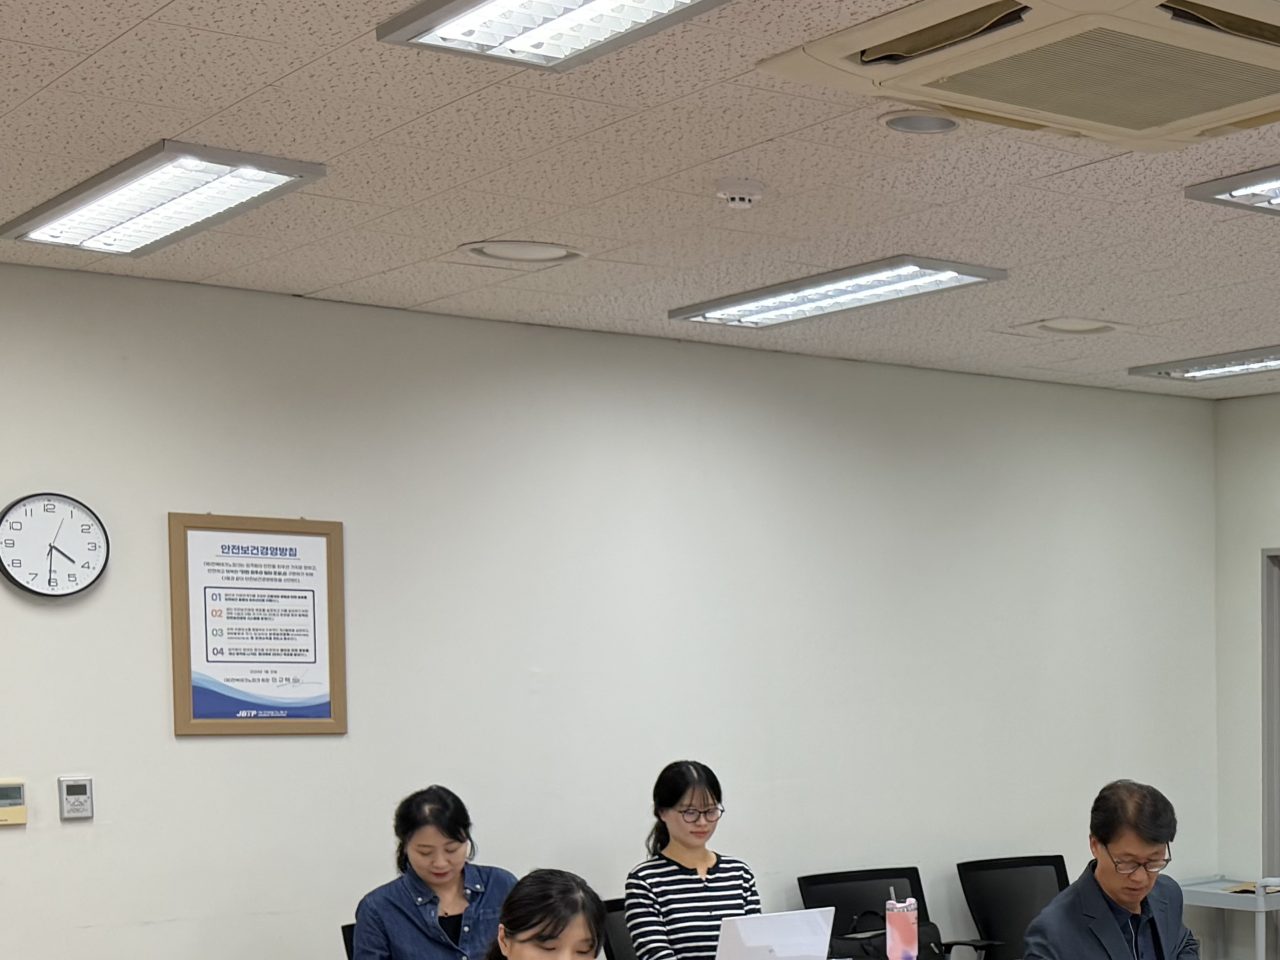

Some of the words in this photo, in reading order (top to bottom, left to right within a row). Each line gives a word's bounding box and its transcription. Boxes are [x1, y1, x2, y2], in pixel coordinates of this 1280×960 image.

[25, 508, 33, 517] 11
[43, 503, 56, 513] 12
[9, 521, 22, 531] 10
[81, 524, 91, 533] 2
[4, 539, 15, 548] 9
[87, 542, 97, 551] 3
[220, 544, 297, 557] 안전보건경영방침
[11, 559, 22, 568] 8
[81, 561, 90, 570] 4
[28, 573, 38, 582] 7
[68, 574, 77, 583] 5
[211, 592, 222, 602] 01
[211, 609, 223, 618] 02
[212, 628, 224, 637] 03
[212, 647, 224, 656] 04
